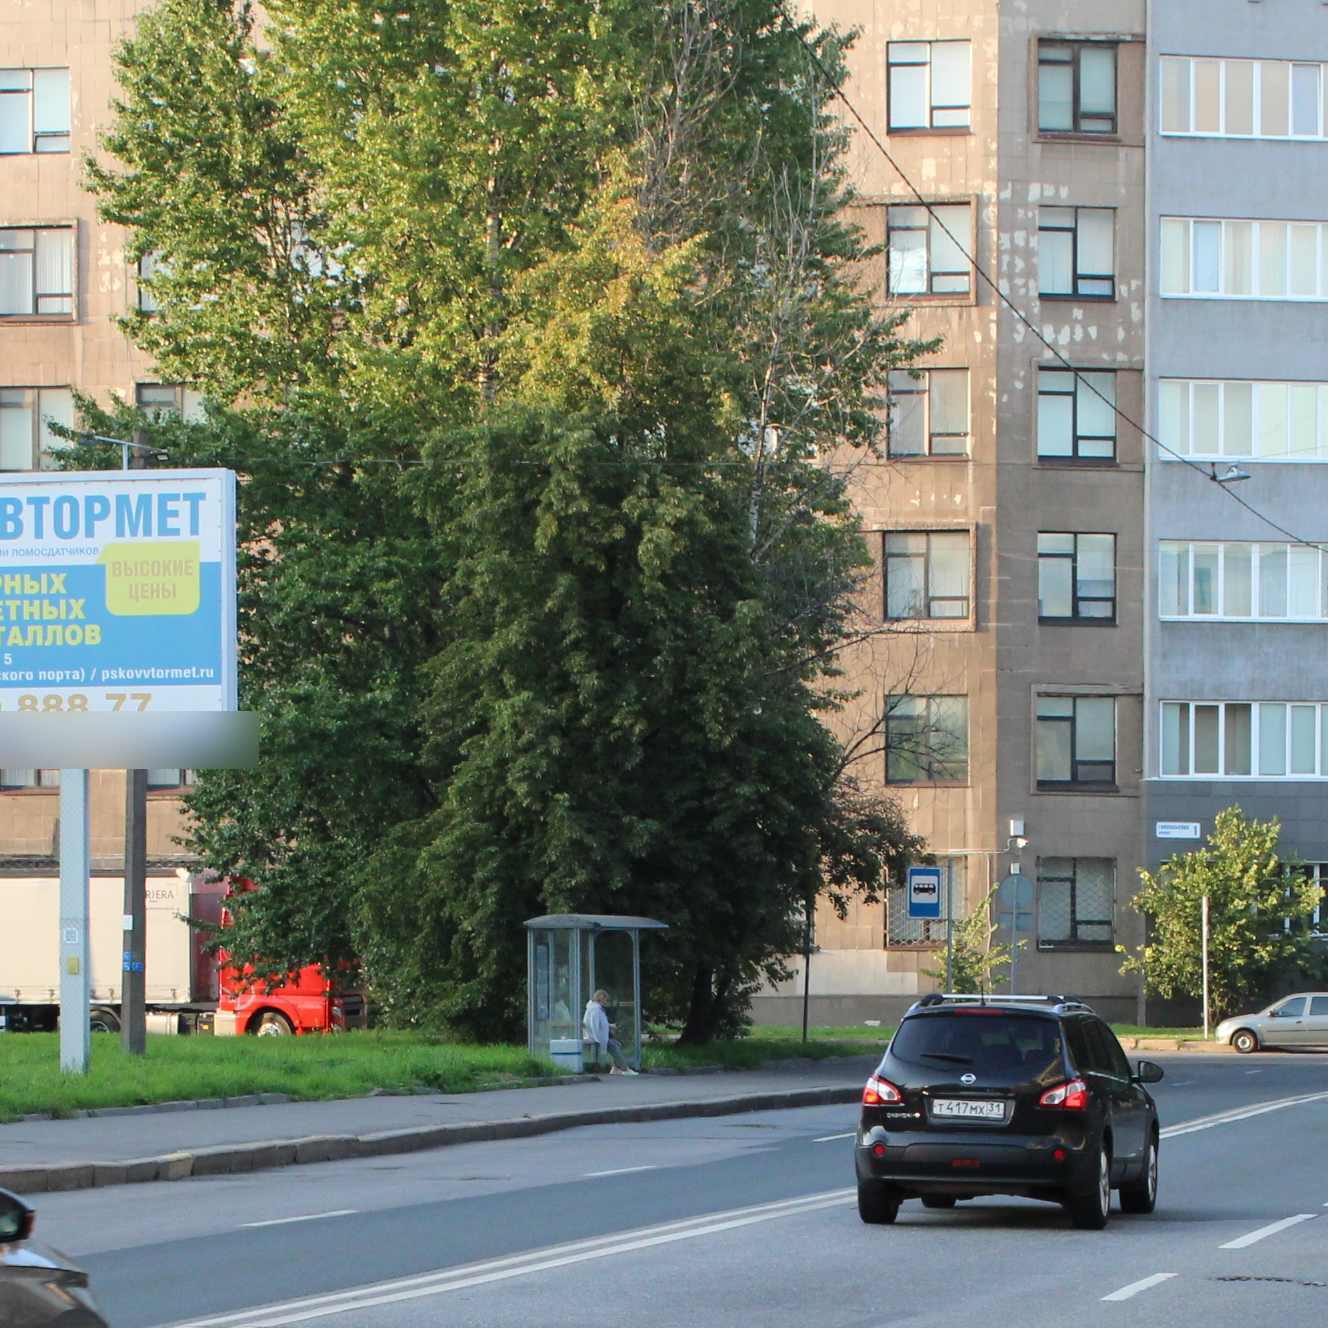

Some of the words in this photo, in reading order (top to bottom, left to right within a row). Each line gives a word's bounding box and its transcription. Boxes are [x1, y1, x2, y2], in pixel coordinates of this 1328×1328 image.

[11, 546, 100, 557] ЛОМОСДАТЧИКОВ
[111, 559, 194, 577] ВЫСОКИЕ
[128, 583, 176, 602] ЦЕНЫ
[4, 653, 12, 665] 5
[39, 668, 85, 683] порта)
[101, 666, 214, 682] pskovvtormet.ru
